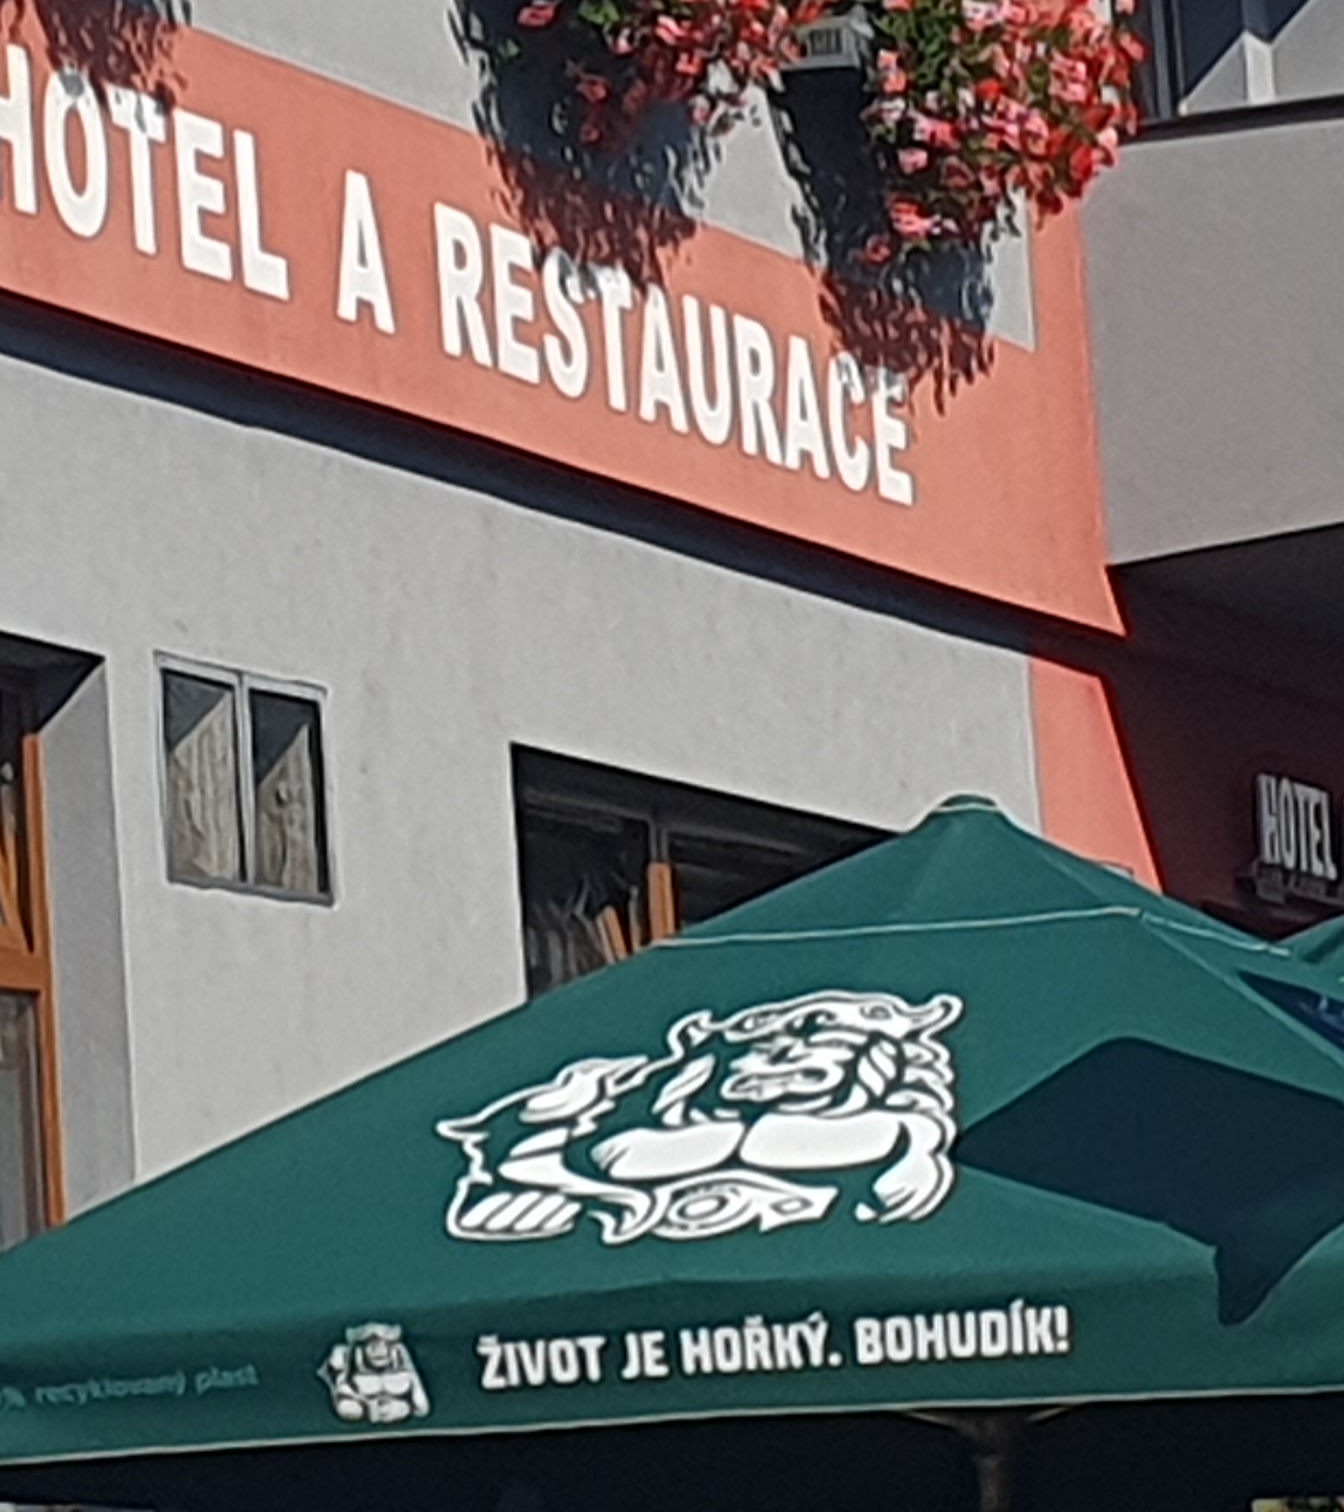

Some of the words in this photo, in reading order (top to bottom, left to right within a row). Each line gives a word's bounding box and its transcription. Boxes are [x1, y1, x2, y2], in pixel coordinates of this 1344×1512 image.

[335, 169, 396, 335] A
[433, 201, 915, 505] RESTAURACE
[1258, 773, 1338, 880] HOTEL
[195, 1363, 260, 1395] plast
[477, 1334, 607, 1390] ŽIVOT
[622, 1330, 669, 1379] JE
[681, 1312, 842, 1375] HOŘKÝ.
[855, 1299, 1070, 1365] BOHUDÍK!
